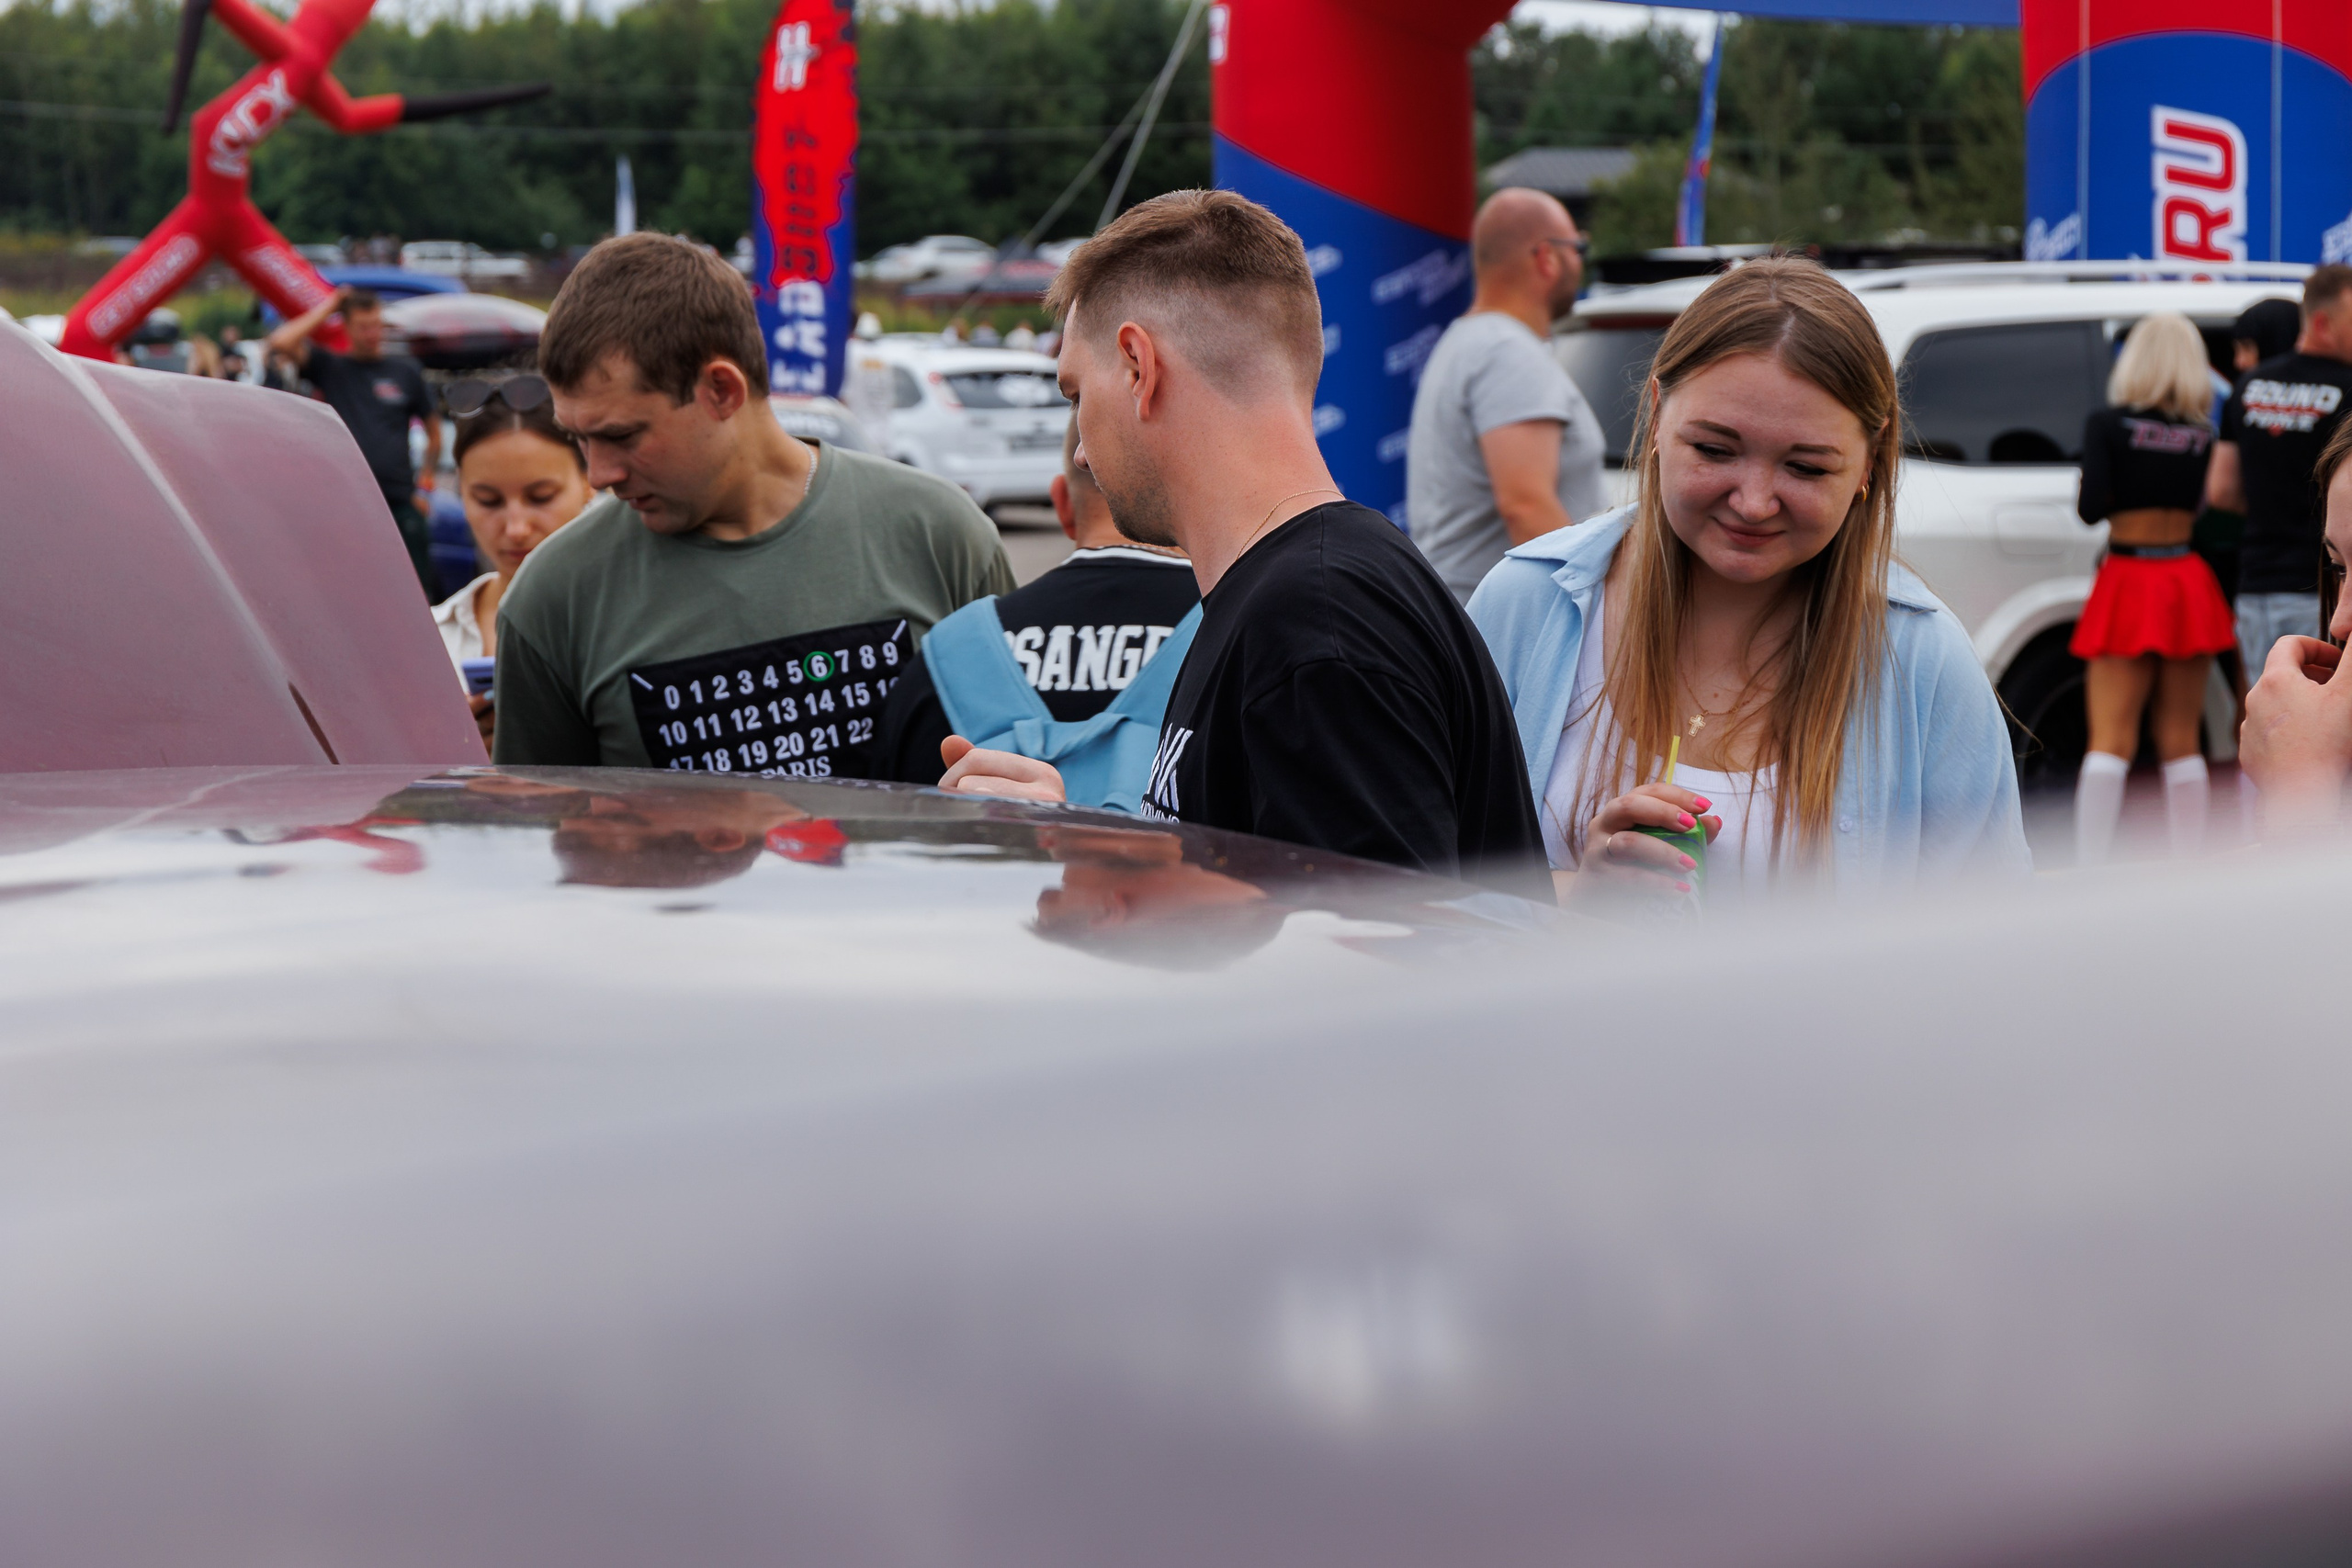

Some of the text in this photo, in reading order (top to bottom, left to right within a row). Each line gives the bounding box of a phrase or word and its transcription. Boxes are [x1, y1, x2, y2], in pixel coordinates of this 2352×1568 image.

[664, 641, 898, 710] 0 1 2 3 4 5 6 7 8 9
[1003, 625, 1175, 691] SANG
[659, 720, 687, 747] 10
[694, 713, 722, 740] 11
[730, 705, 762, 732] 12
[768, 697, 797, 725] 13
[805, 689, 835, 716] 14
[842, 682, 870, 708] 15
[702, 748, 731, 772] 18
[738, 740, 768, 768] 19
[774, 732, 804, 760] 20
[810, 724, 840, 752] 21
[847, 717, 874, 745] 22
